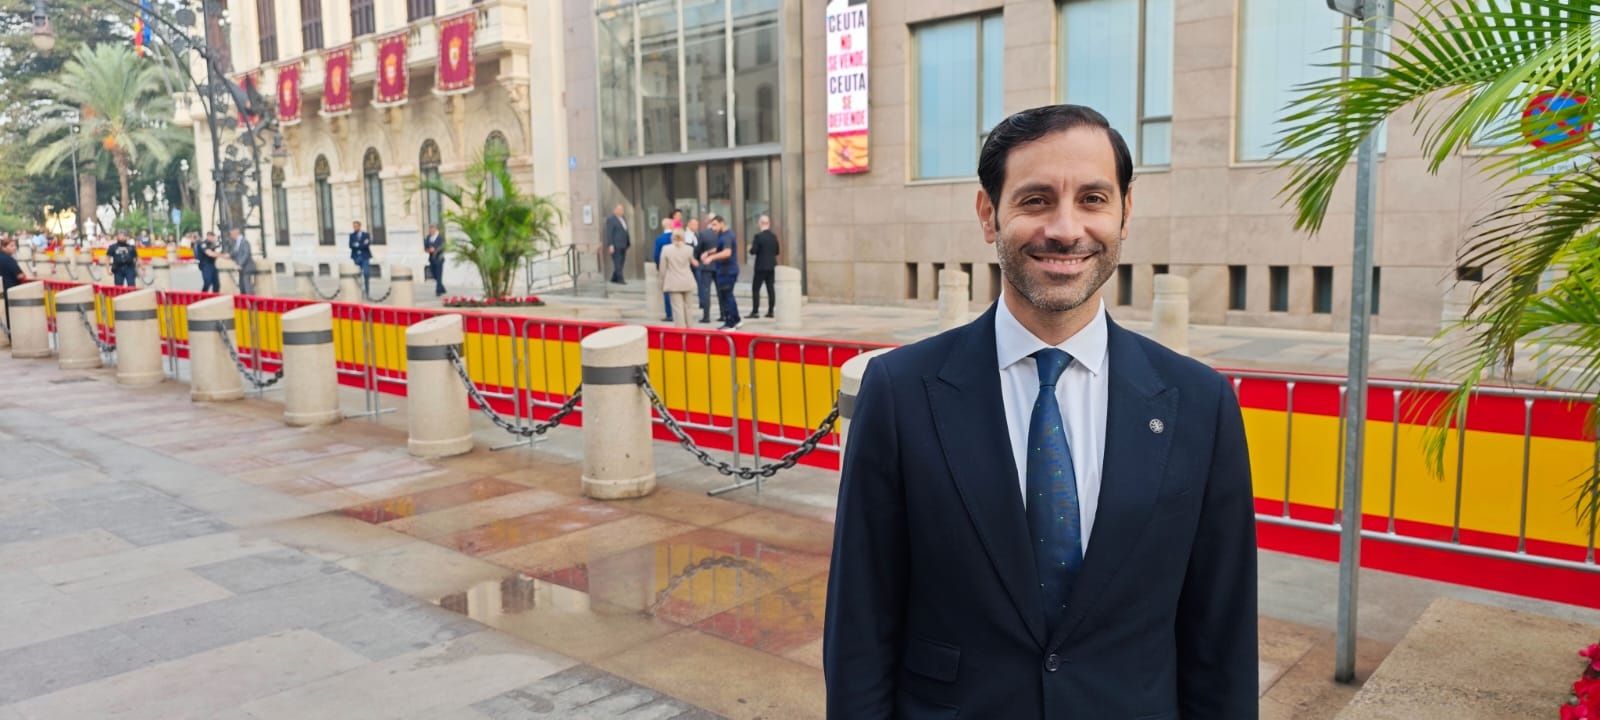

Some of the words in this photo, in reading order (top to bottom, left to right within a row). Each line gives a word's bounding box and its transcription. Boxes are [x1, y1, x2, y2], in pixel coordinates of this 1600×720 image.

[828, 10, 865, 33] CEUTA
[841, 34, 852, 50] NO
[828, 55, 837, 71] SE
[830, 72, 866, 94] CEUTA
[843, 95, 852, 110] SE
[828, 110, 865, 128] DEFIENDE
